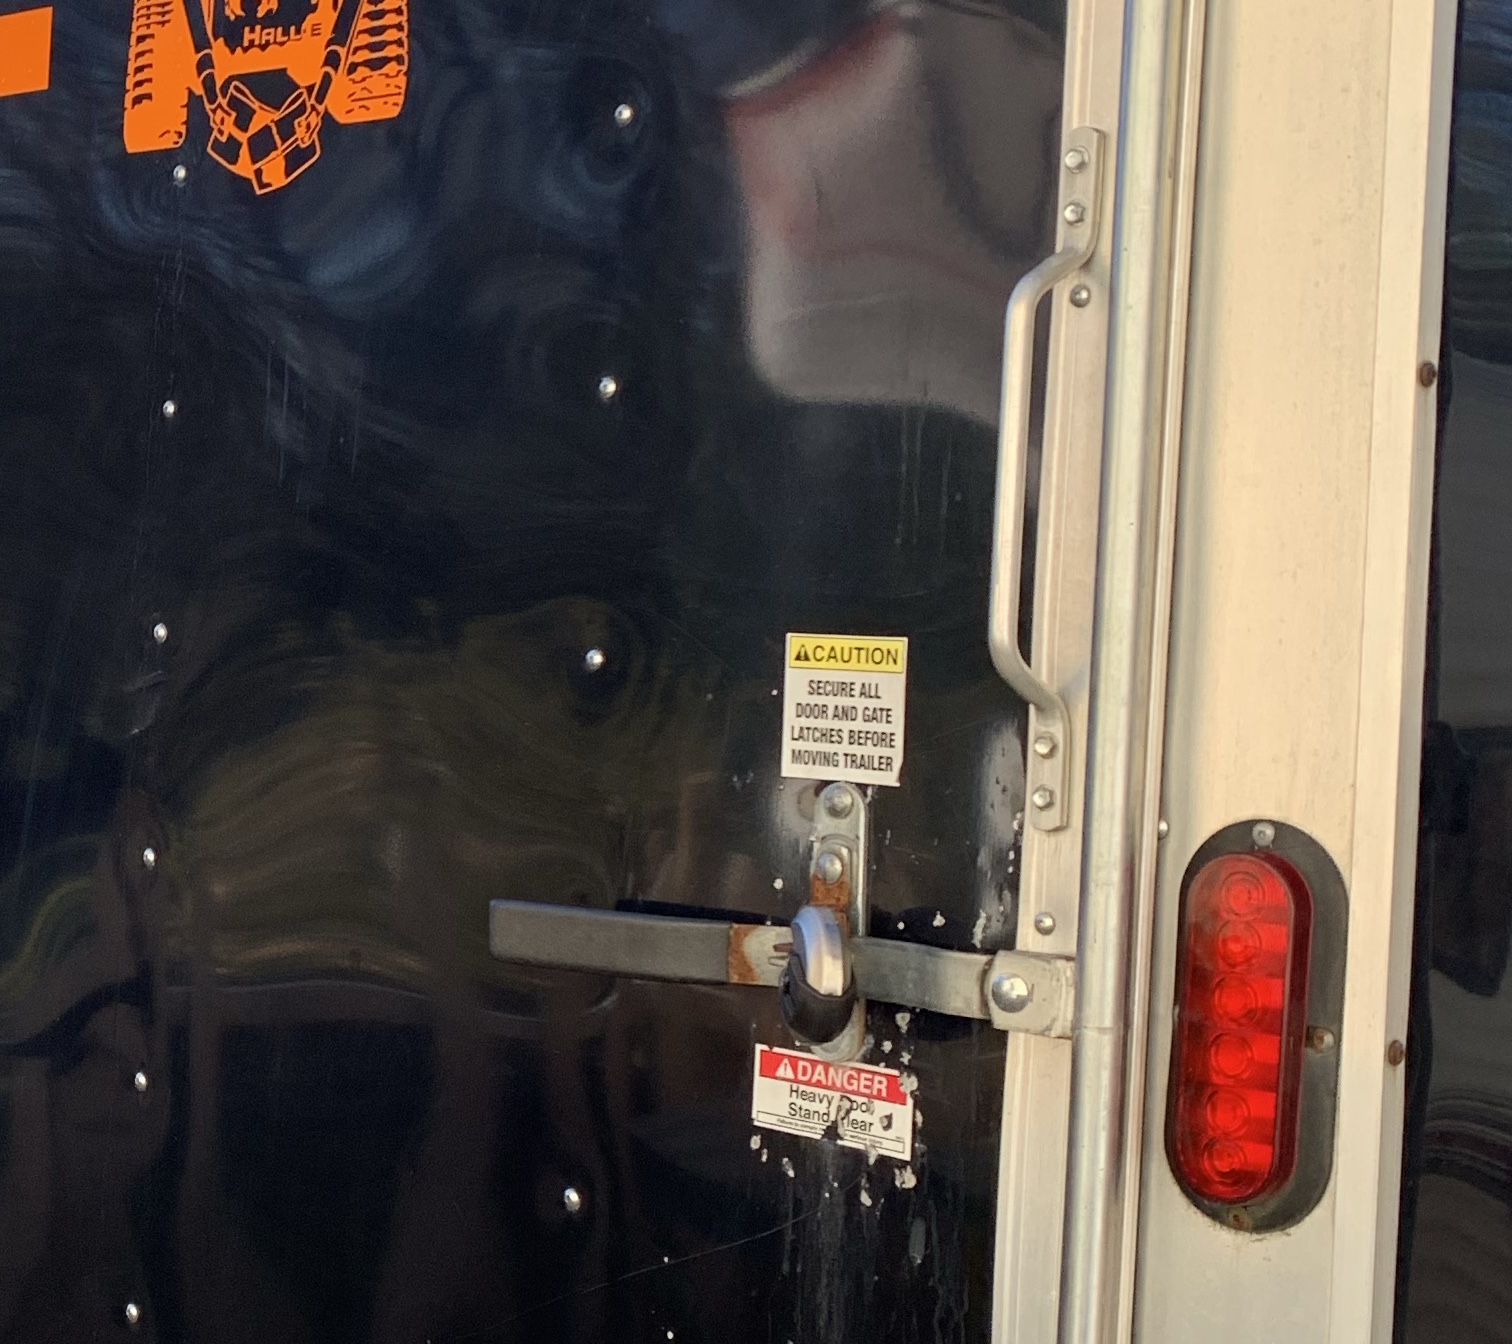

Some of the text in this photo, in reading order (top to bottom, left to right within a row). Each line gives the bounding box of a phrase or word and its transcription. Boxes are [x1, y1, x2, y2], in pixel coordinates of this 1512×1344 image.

[812, 644, 899, 666] CAUTION
[807, 679, 882, 700] SECURE ALL
[795, 702, 893, 725] DOOR AND GATE
[790, 725, 896, 749] LATCHES BEFORE
[791, 748, 894, 773] MOVING TRAILER
[797, 1059, 888, 1098] DANGER
[789, 1083, 835, 1110] Heavy
[787, 1101, 831, 1124] Stand
